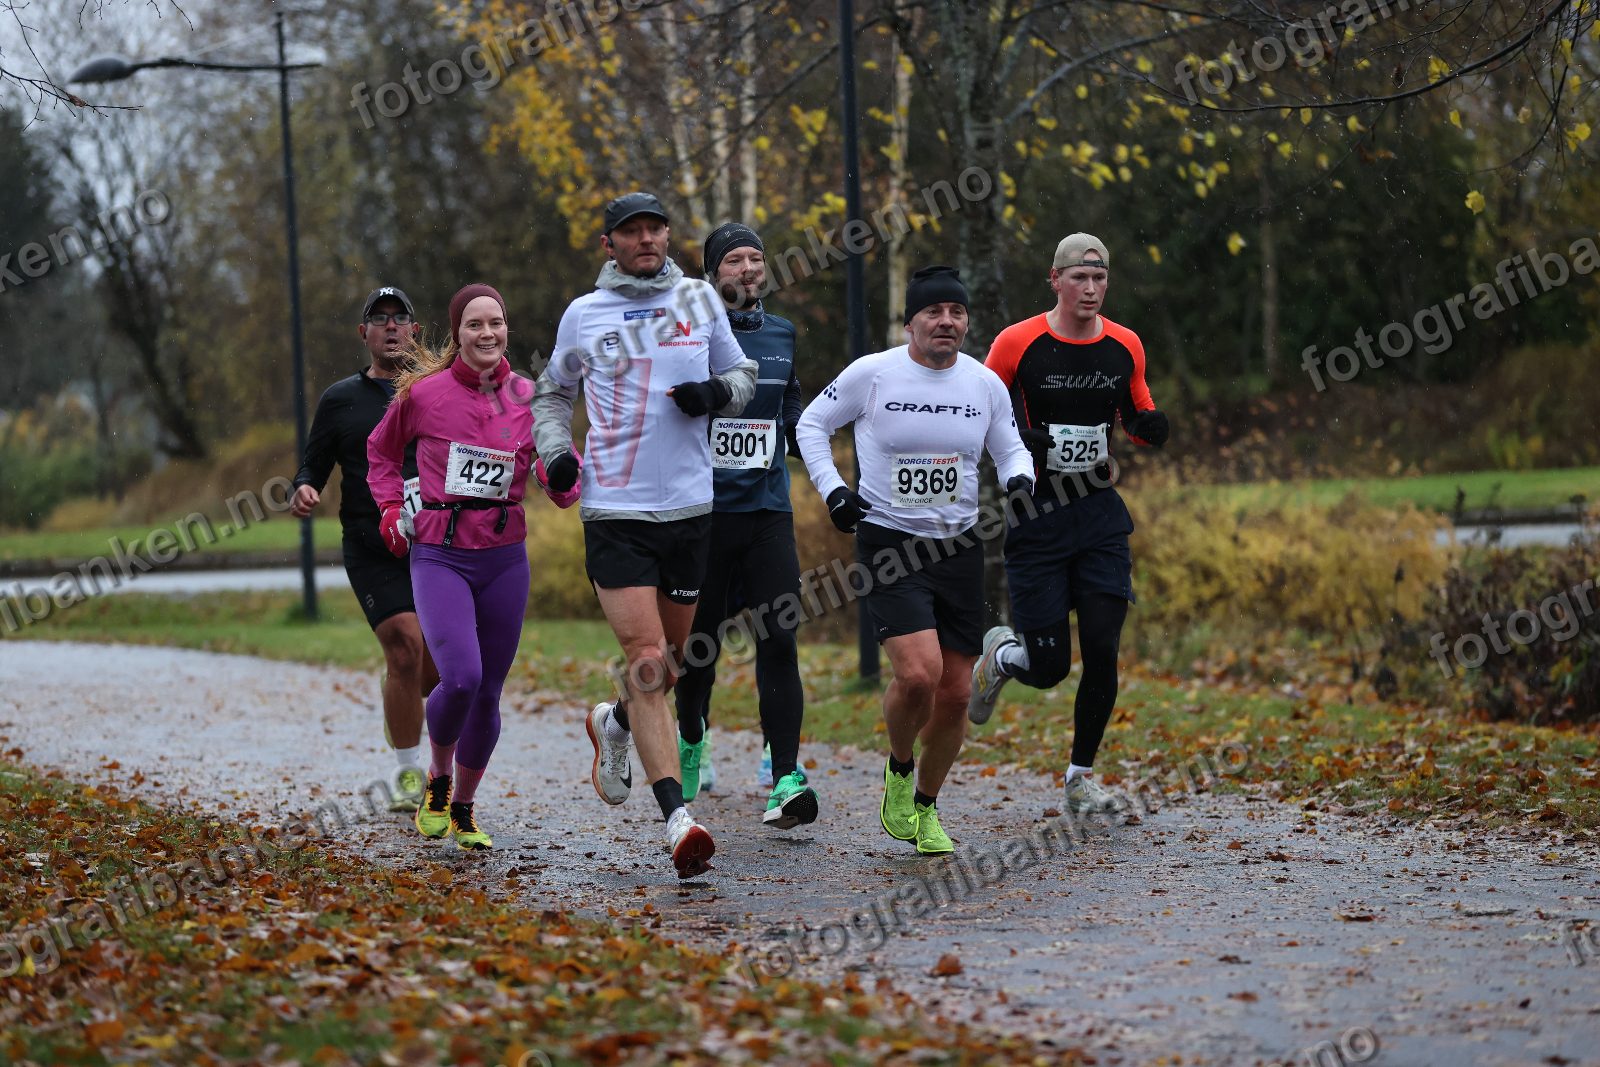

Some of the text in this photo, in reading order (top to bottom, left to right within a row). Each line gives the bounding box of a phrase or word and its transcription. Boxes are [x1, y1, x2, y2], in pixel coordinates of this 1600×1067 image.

[885, 402, 962, 415] CRAFT
[717, 422, 771, 430] NORGESTESTEN
[715, 432, 767, 457] 3001
[1060, 440, 1099, 462] 525
[897, 456, 959, 465] NORGESTESTEN
[459, 459, 505, 487] 422
[898, 467, 958, 495] 9369
